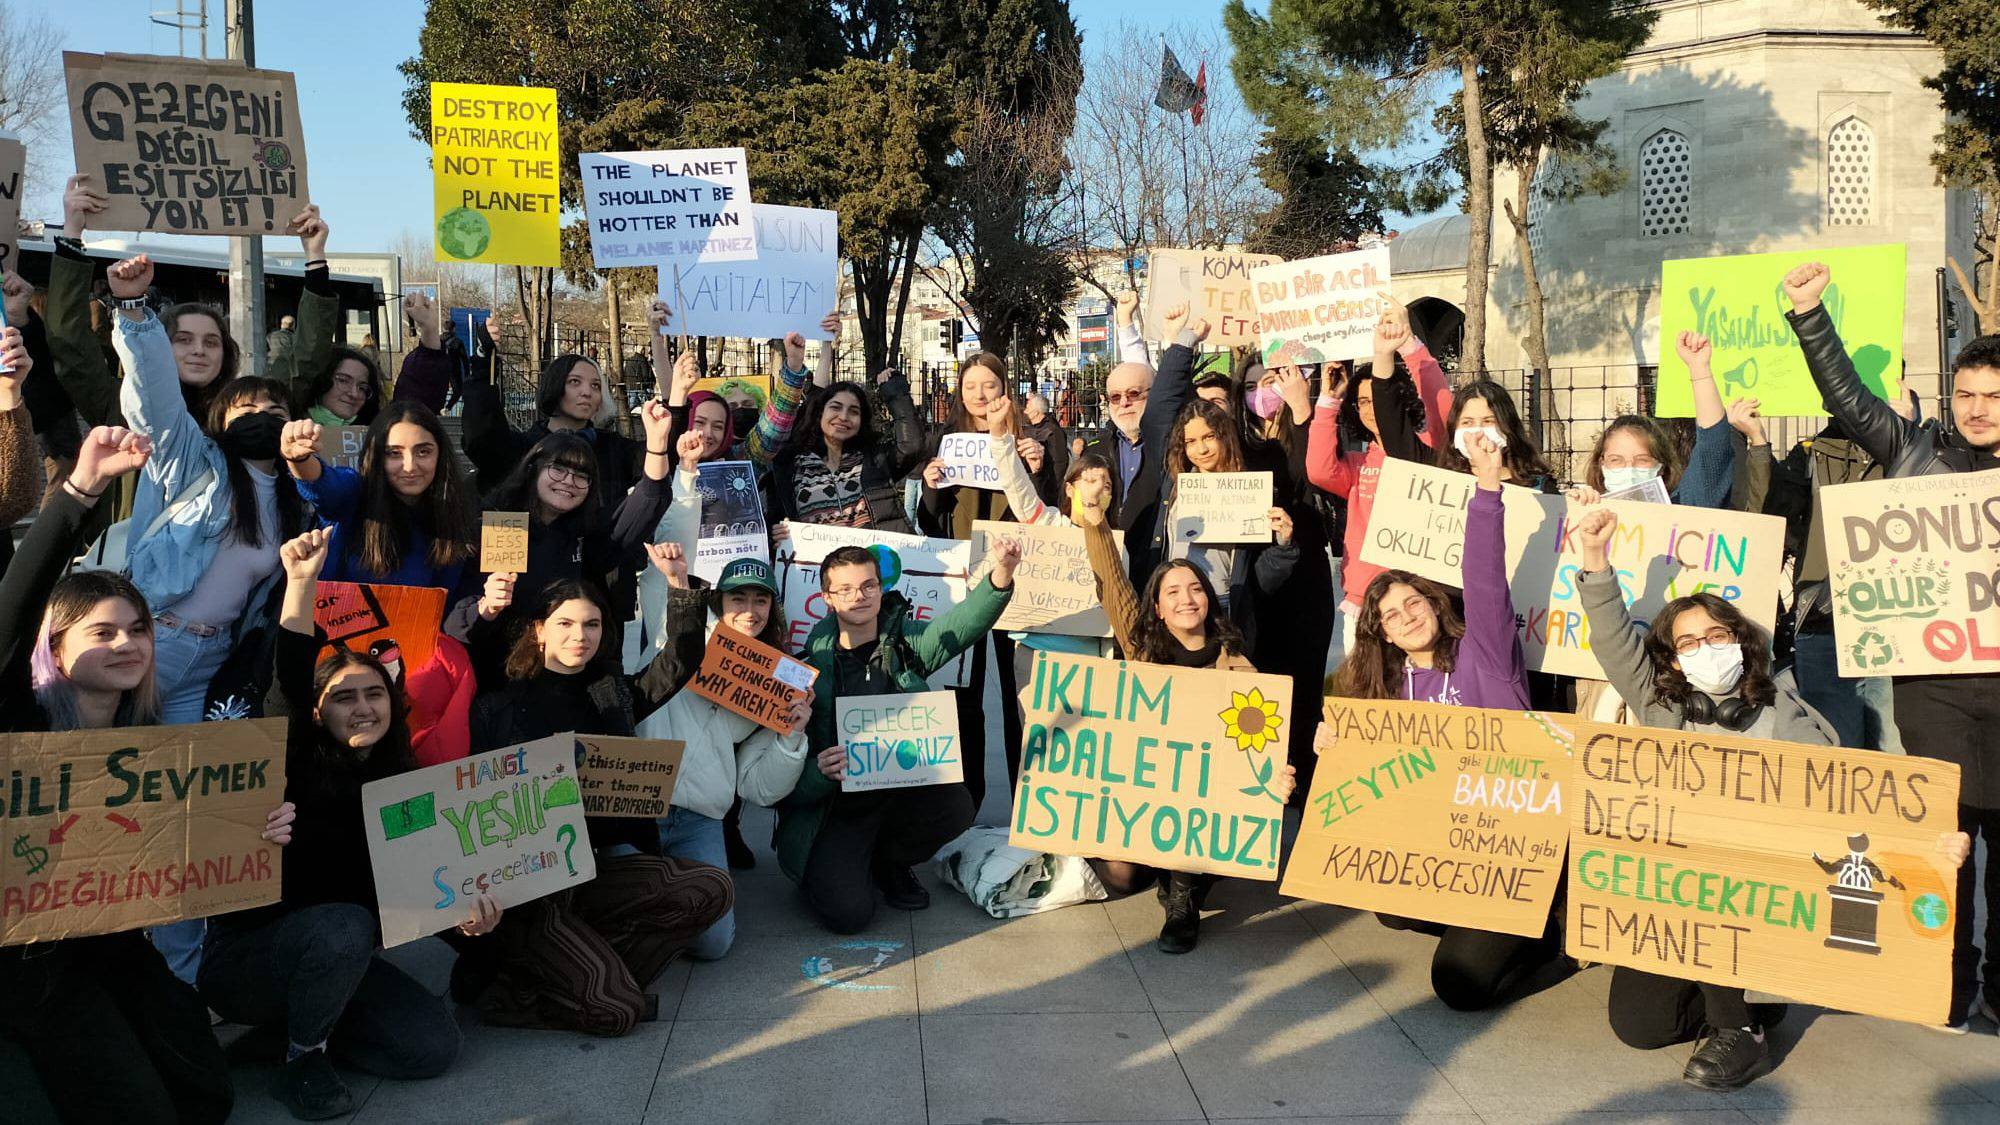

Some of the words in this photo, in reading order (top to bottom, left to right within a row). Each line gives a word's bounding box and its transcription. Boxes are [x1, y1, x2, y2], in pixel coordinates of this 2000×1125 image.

[82, 81, 283, 141] GEZEGENİ
[443, 97, 553, 122] DESTROY
[136, 126, 231, 167] DEĞİL
[434, 125, 553, 151] PATRIARCHY
[444, 156, 498, 177] NOT
[507, 158, 554, 180] THE
[591, 164, 631, 180] THE
[652, 161, 738, 178] PLANET
[462, 189, 555, 213] PLANET
[599, 187, 702, 206] SHOULDN'T
[713, 186, 734, 202] BE
[141, 199, 209, 230] YOK
[599, 214, 677, 233] HOTTER
[686, 212, 740, 229] THAN
[600, 240, 674, 259] MELANIE
[678, 237, 753, 255] MARTINEZ
[1257, 280, 1287, 304] BU
[1294, 269, 1327, 299] BİR
[1329, 262, 1388, 291] ACİL
[1259, 308, 1313, 334] DURUM
[943, 438, 993, 459] PEOP
[1216, 478, 1264, 490] YAKITLARI
[486, 535, 523, 548] LESS
[492, 519, 523, 533] USE
[486, 550, 525, 565] PAPER
[1376, 527, 1437, 561] OKUL
[1665, 523, 1748, 577] İÇİN
[1847, 575, 1937, 613] OLUR
[716, 634, 736, 653] THE
[736, 644, 774, 670] CLIMATE
[719, 656, 733, 671] IS
[731, 662, 796, 703] CHANGING
[1032, 651, 1173, 726] İKLİM
[694, 672, 733, 697] WHY
[729, 686, 780, 721] AREN'T
[843, 706, 942, 735] GELECEK
[1328, 703, 1453, 750] YAŞAMAK
[1464, 712, 1507, 753] BİR
[627, 760, 674, 776] getting
[1024, 723, 1212, 798] ADALETİ
[1457, 754, 1481, 771] gibi
[1484, 755, 1545, 778] UMUT
[1540, 771, 1550, 780] ve
[611, 778, 640, 792] than
[642, 785, 662, 799] my
[1313, 745, 1437, 829] ZEYTİN
[1581, 732, 1783, 804] GEÇMİŞTEN
[1804, 757, 1930, 823] MİRAS
[612, 796, 666, 816] BOYFRIEND
[1453, 773, 1563, 817] BARIŞLA
[1016, 775, 1282, 870] İSTİYORUZ!
[1450, 812, 1469, 824] ve
[1476, 811, 1501, 829] bir
[1584, 788, 1688, 849] DEĞİL
[1449, 827, 1527, 859] ORMAN
[1527, 839, 1558, 863] gibi
[1322, 843, 1545, 902] KARDEŞÇESİNE
[1578, 848, 1818, 933] GELECEKTEN
[1579, 902, 1751, 976] EMANET
